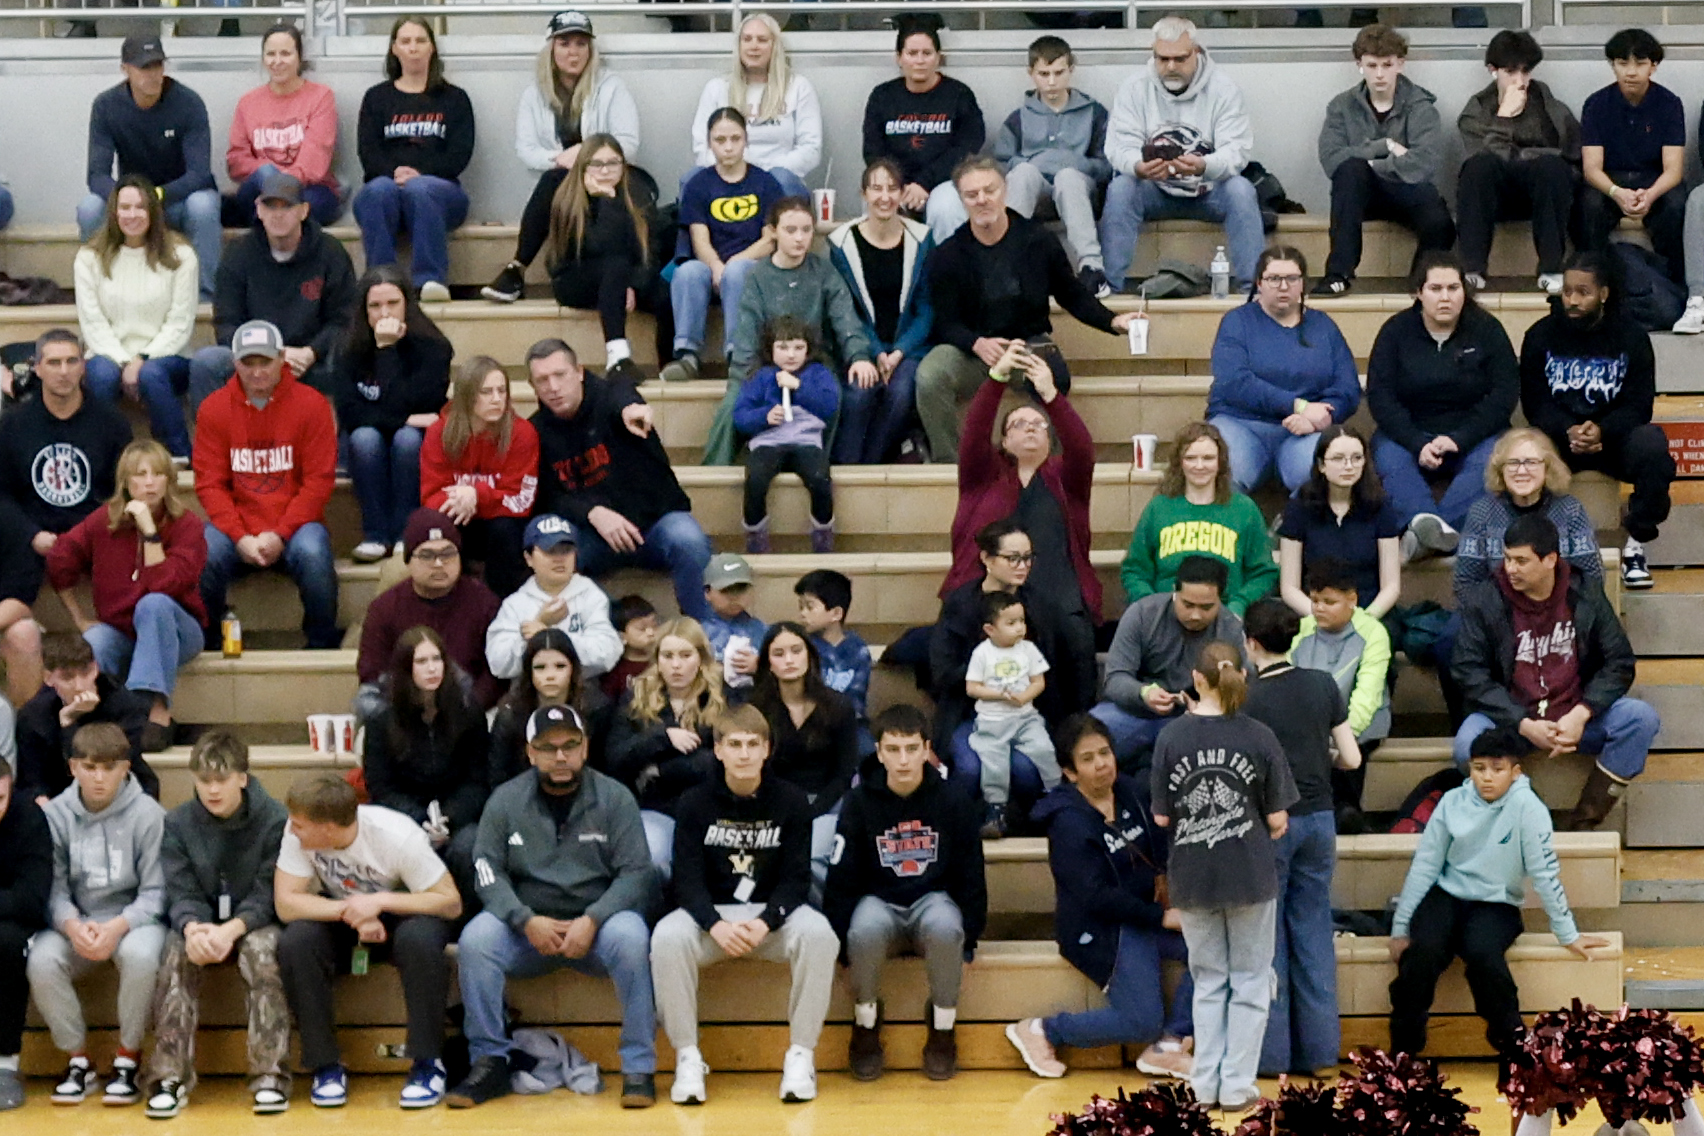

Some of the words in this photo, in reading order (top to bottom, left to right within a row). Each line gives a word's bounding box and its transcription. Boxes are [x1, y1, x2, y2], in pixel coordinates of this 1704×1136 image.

[253, 123, 304, 150] BASKETBA
[885, 119, 951, 135] BASKETBALL
[1669, 438, 1684, 448] NOT
[1683, 451, 1704, 460] WHEN
[230, 445, 294, 474] ASETBALL
[1159, 520, 1238, 564] OREGON
[1197, 748, 1226, 767] AND
[1229, 752, 1257, 786] FREE
[704, 824, 781, 849] BASEBALL
